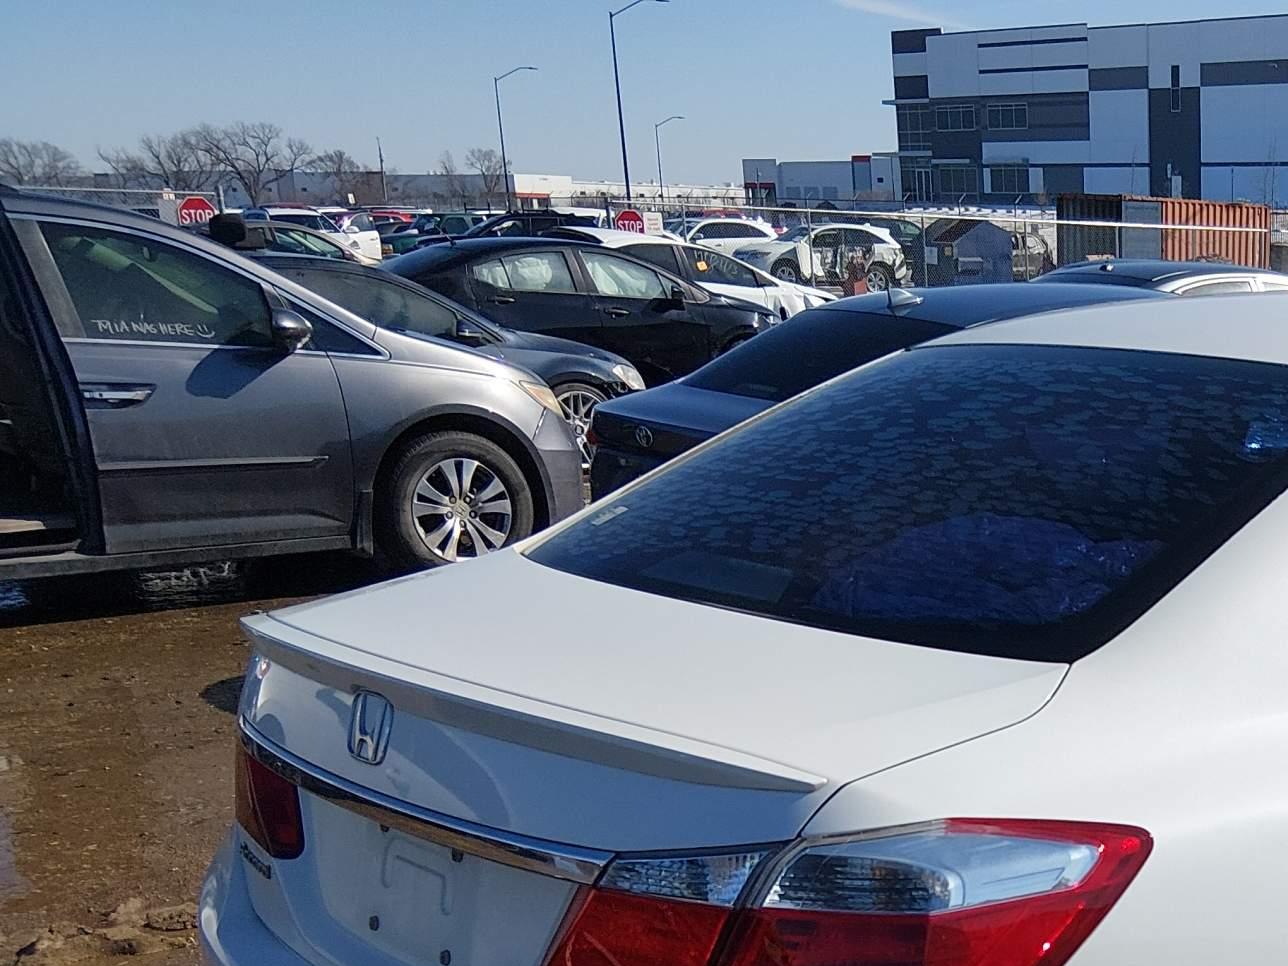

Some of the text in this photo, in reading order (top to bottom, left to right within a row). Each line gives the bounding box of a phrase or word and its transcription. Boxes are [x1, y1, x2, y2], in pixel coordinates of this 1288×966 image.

[181, 209, 213, 225] STOP
[618, 220, 643, 233] STOP
[159, 322, 195, 336] HERE
